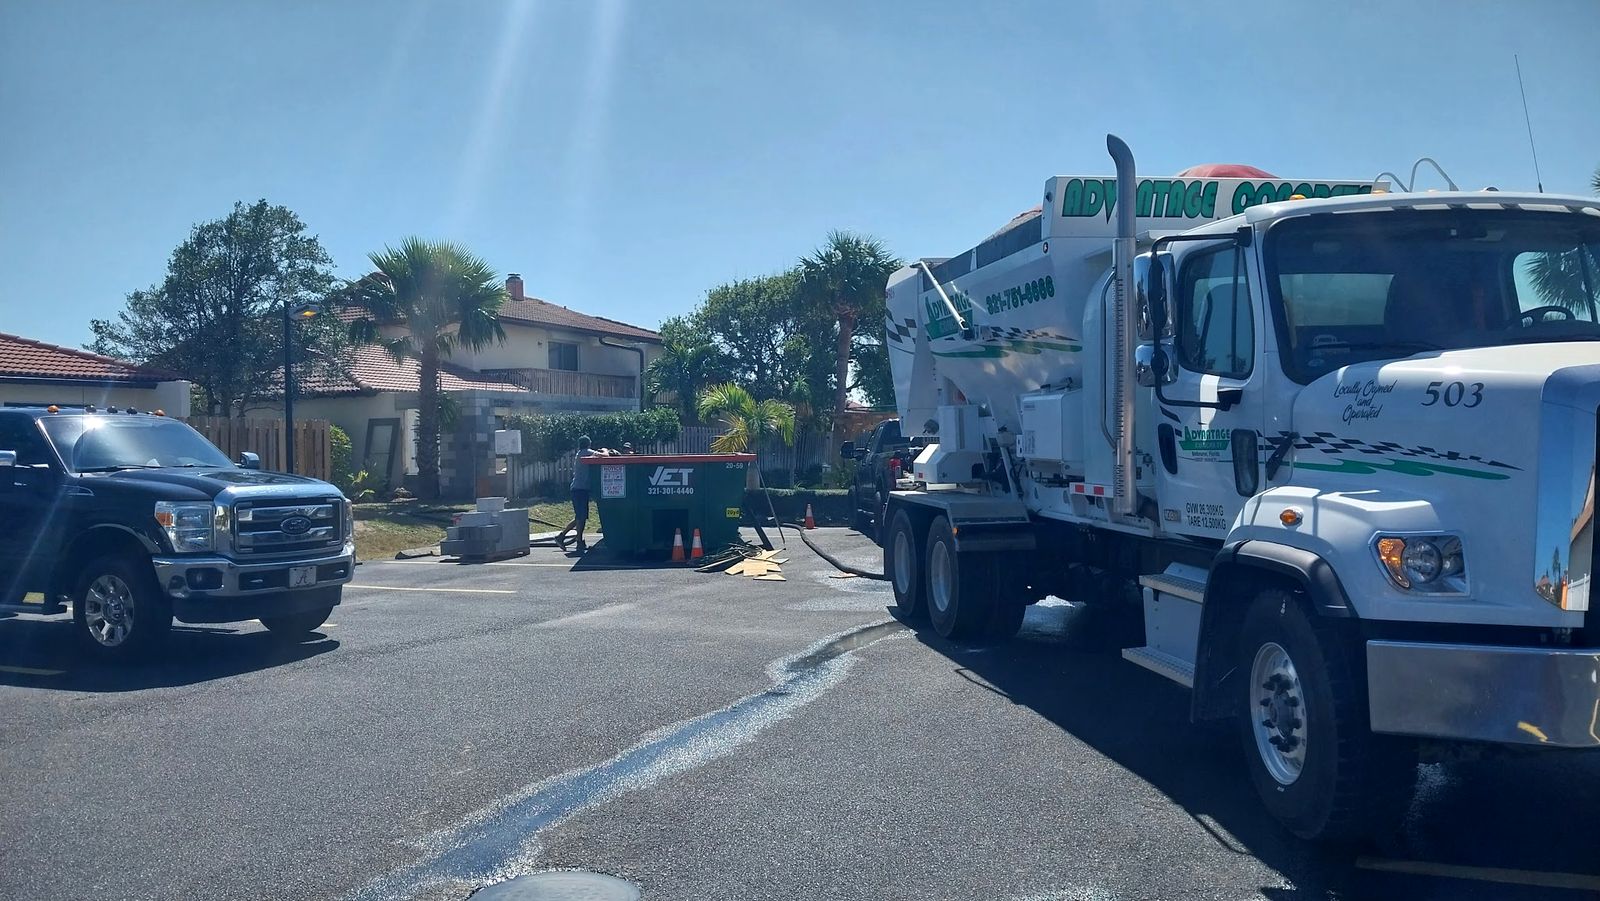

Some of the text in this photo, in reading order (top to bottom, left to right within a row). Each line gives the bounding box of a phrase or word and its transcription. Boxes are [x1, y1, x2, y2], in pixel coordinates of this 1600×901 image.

[1062, 179, 1218, 224] ADVNTAGE
[1334, 379, 1398, 401] Locally Owned
[1357, 391, 1377, 406] and
[1421, 381, 1485, 408] 503
[1343, 404, 1383, 425] Operated
[648, 465, 694, 486] JET
[647, 487, 694, 495] 321-301-4440
[1186, 502, 1199, 514] GVW
